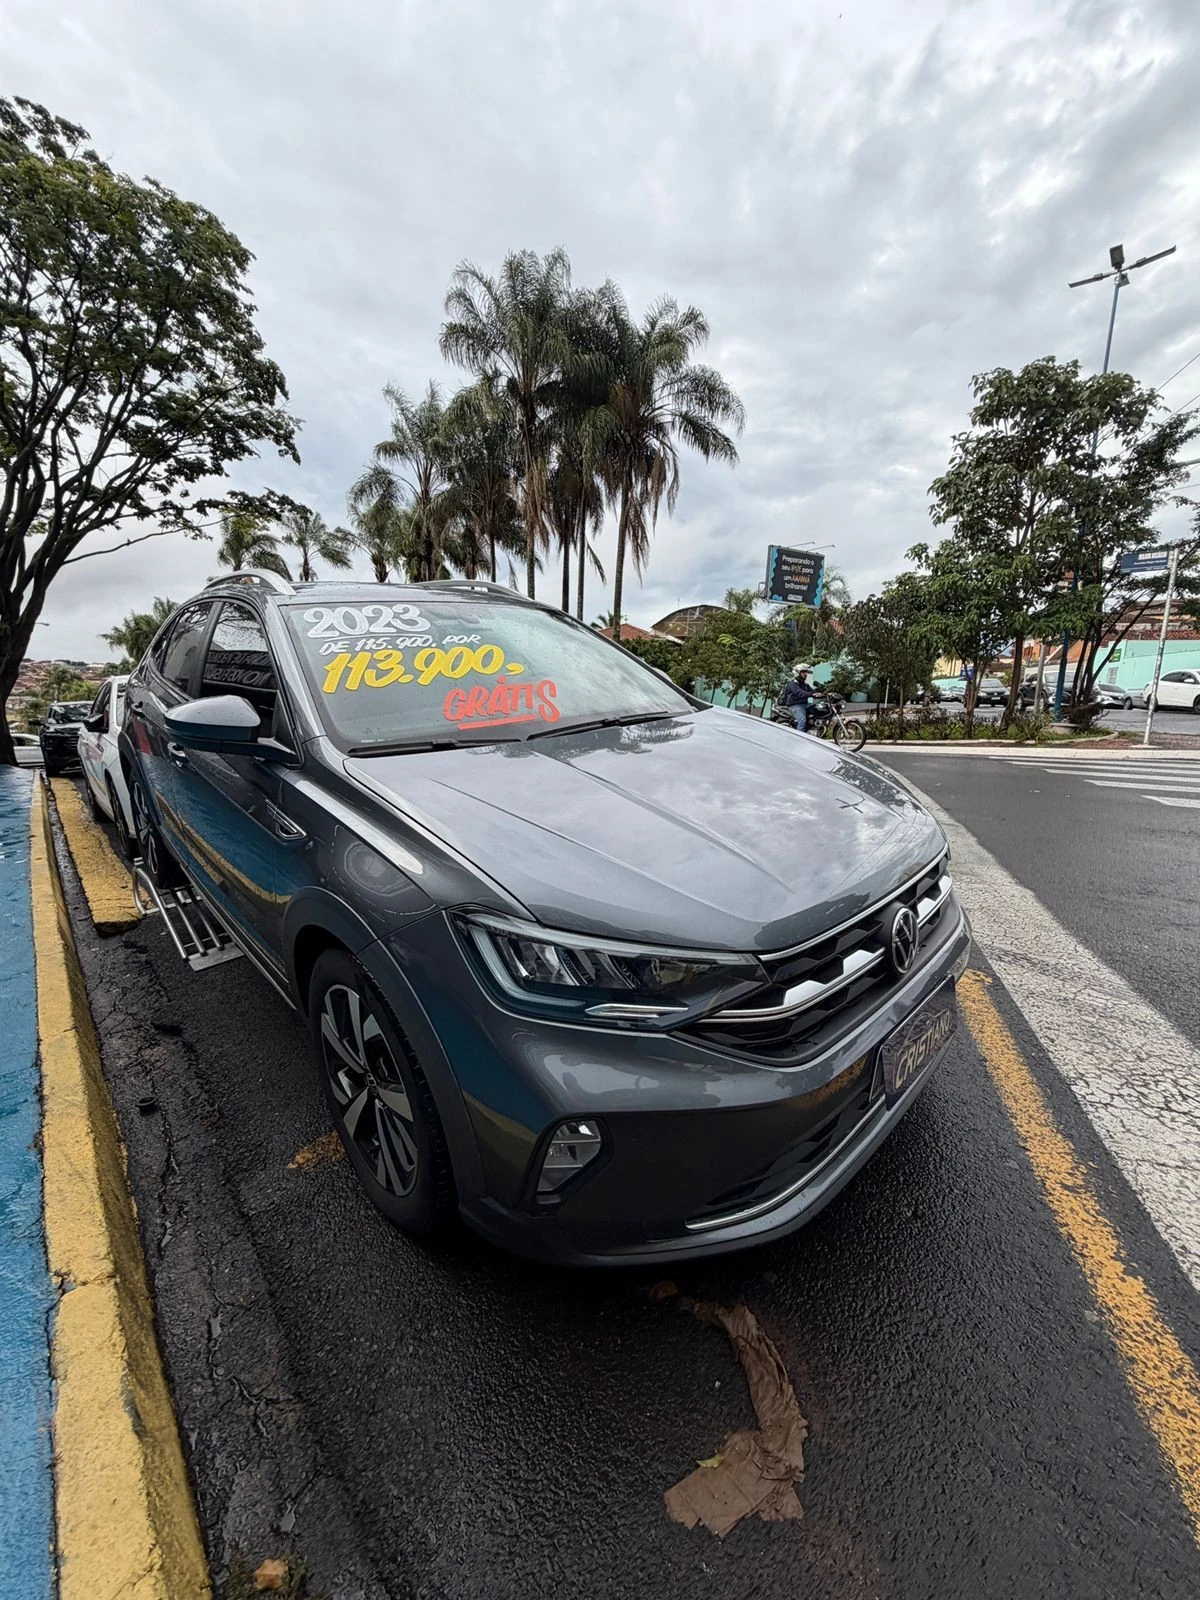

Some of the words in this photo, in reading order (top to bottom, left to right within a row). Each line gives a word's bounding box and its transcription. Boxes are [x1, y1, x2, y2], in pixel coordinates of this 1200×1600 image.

[782, 555, 811, 565] Preparando
[303, 604, 431, 638] 2023
[319, 641, 349, 655] DE
[442, 634, 481, 645] POR
[442, 675, 560, 722] GRÁTIS
[895, 1011, 950, 1089] CRISTIANO
